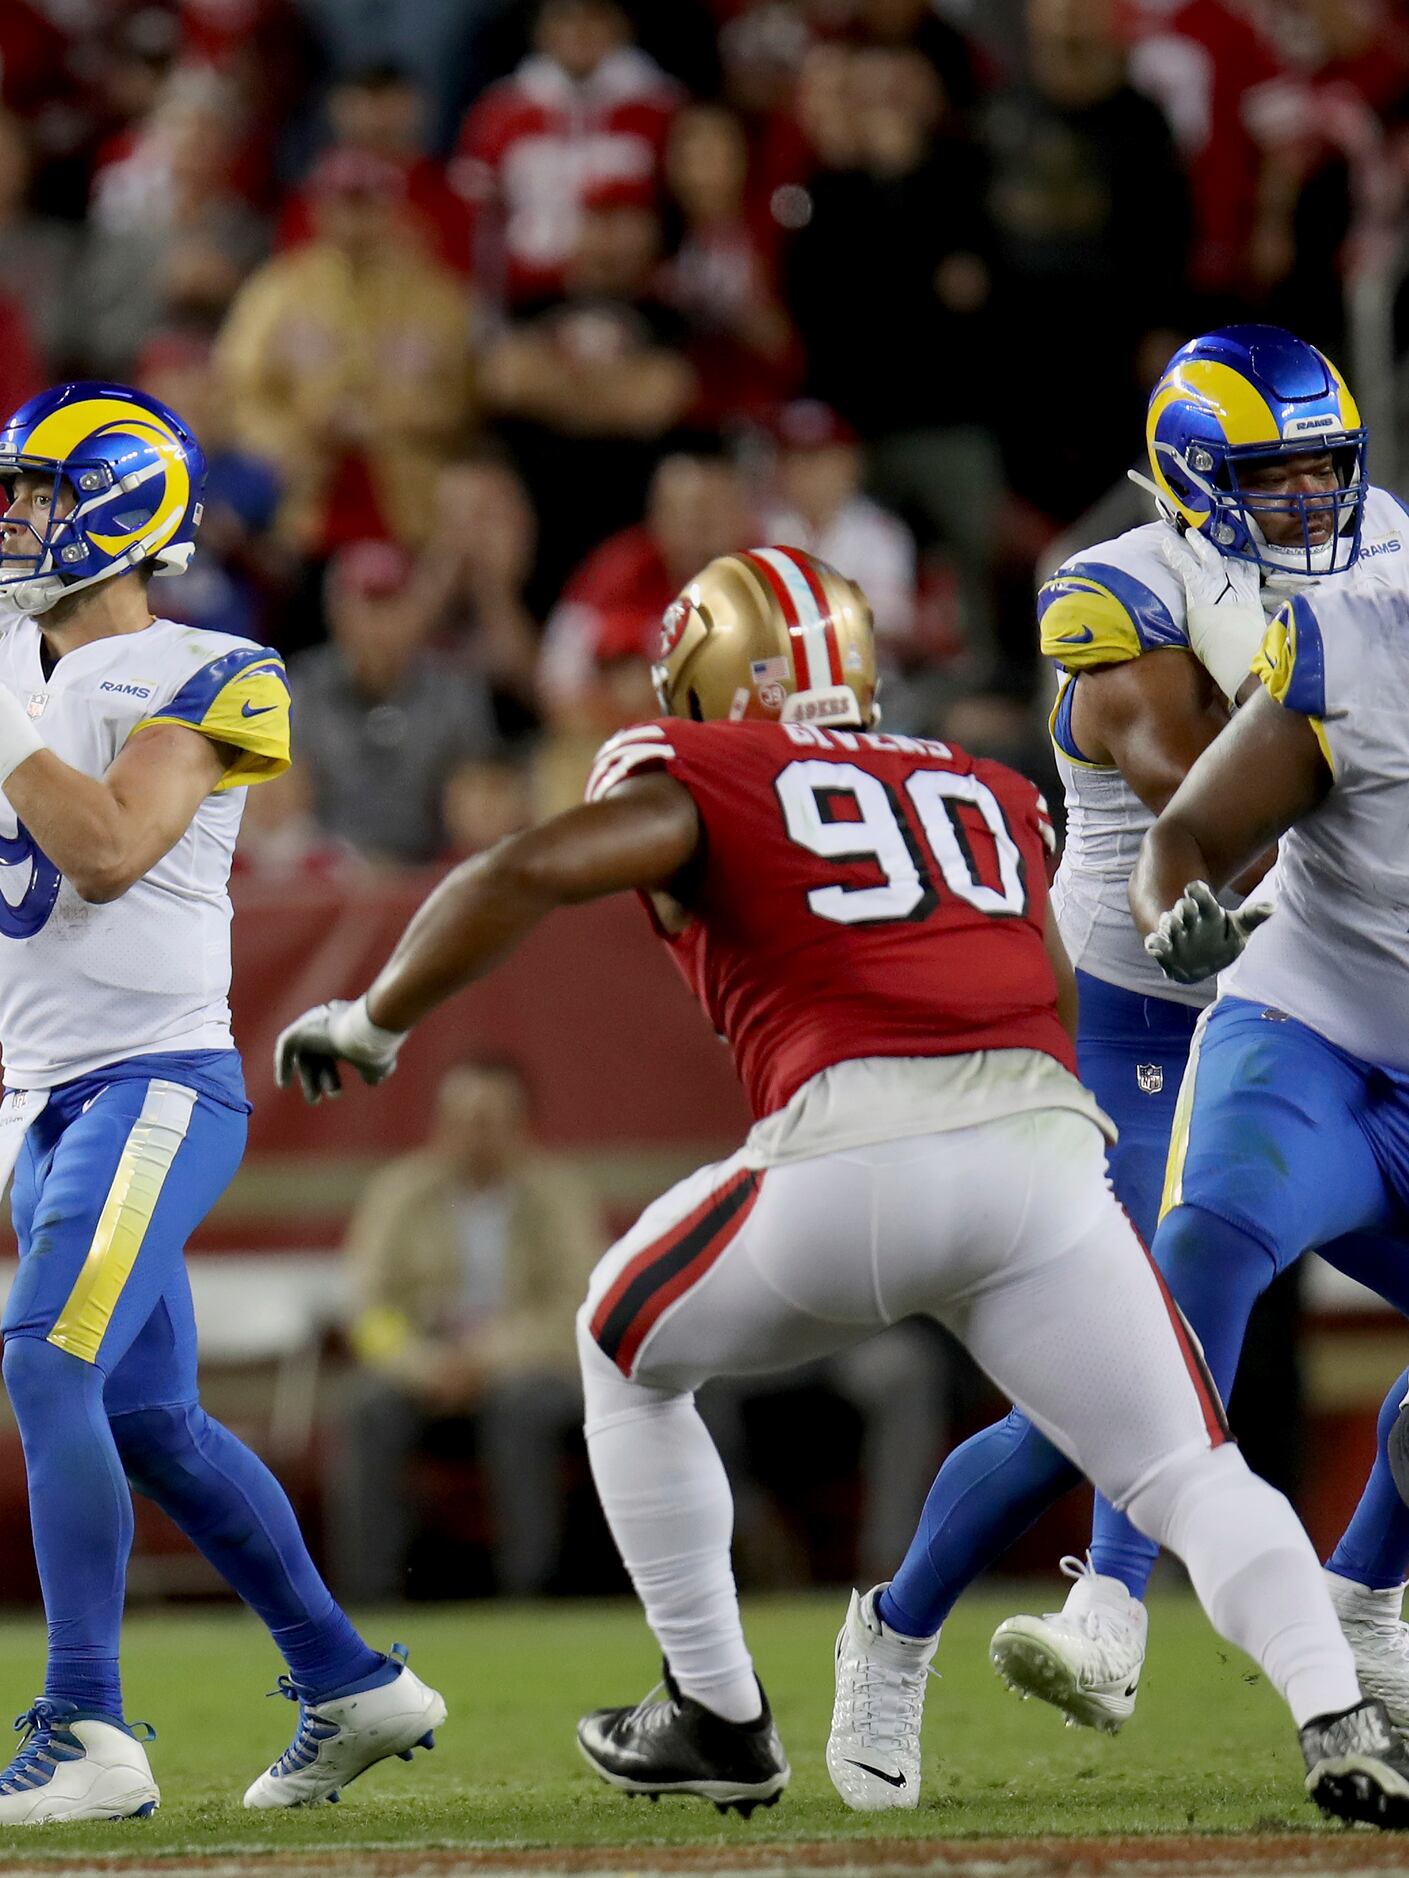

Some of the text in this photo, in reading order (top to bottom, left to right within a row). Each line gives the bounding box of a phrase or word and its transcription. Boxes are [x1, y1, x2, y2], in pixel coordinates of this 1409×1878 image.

[1296, 418, 1333, 430] RAMS
[1360, 539, 1401, 560] RAMS
[100, 681, 151, 699] RAMS
[794, 699, 849, 720] 49ERS
[774, 759, 1030, 926] 90
[1141, 1075, 1160, 1089] NFL
